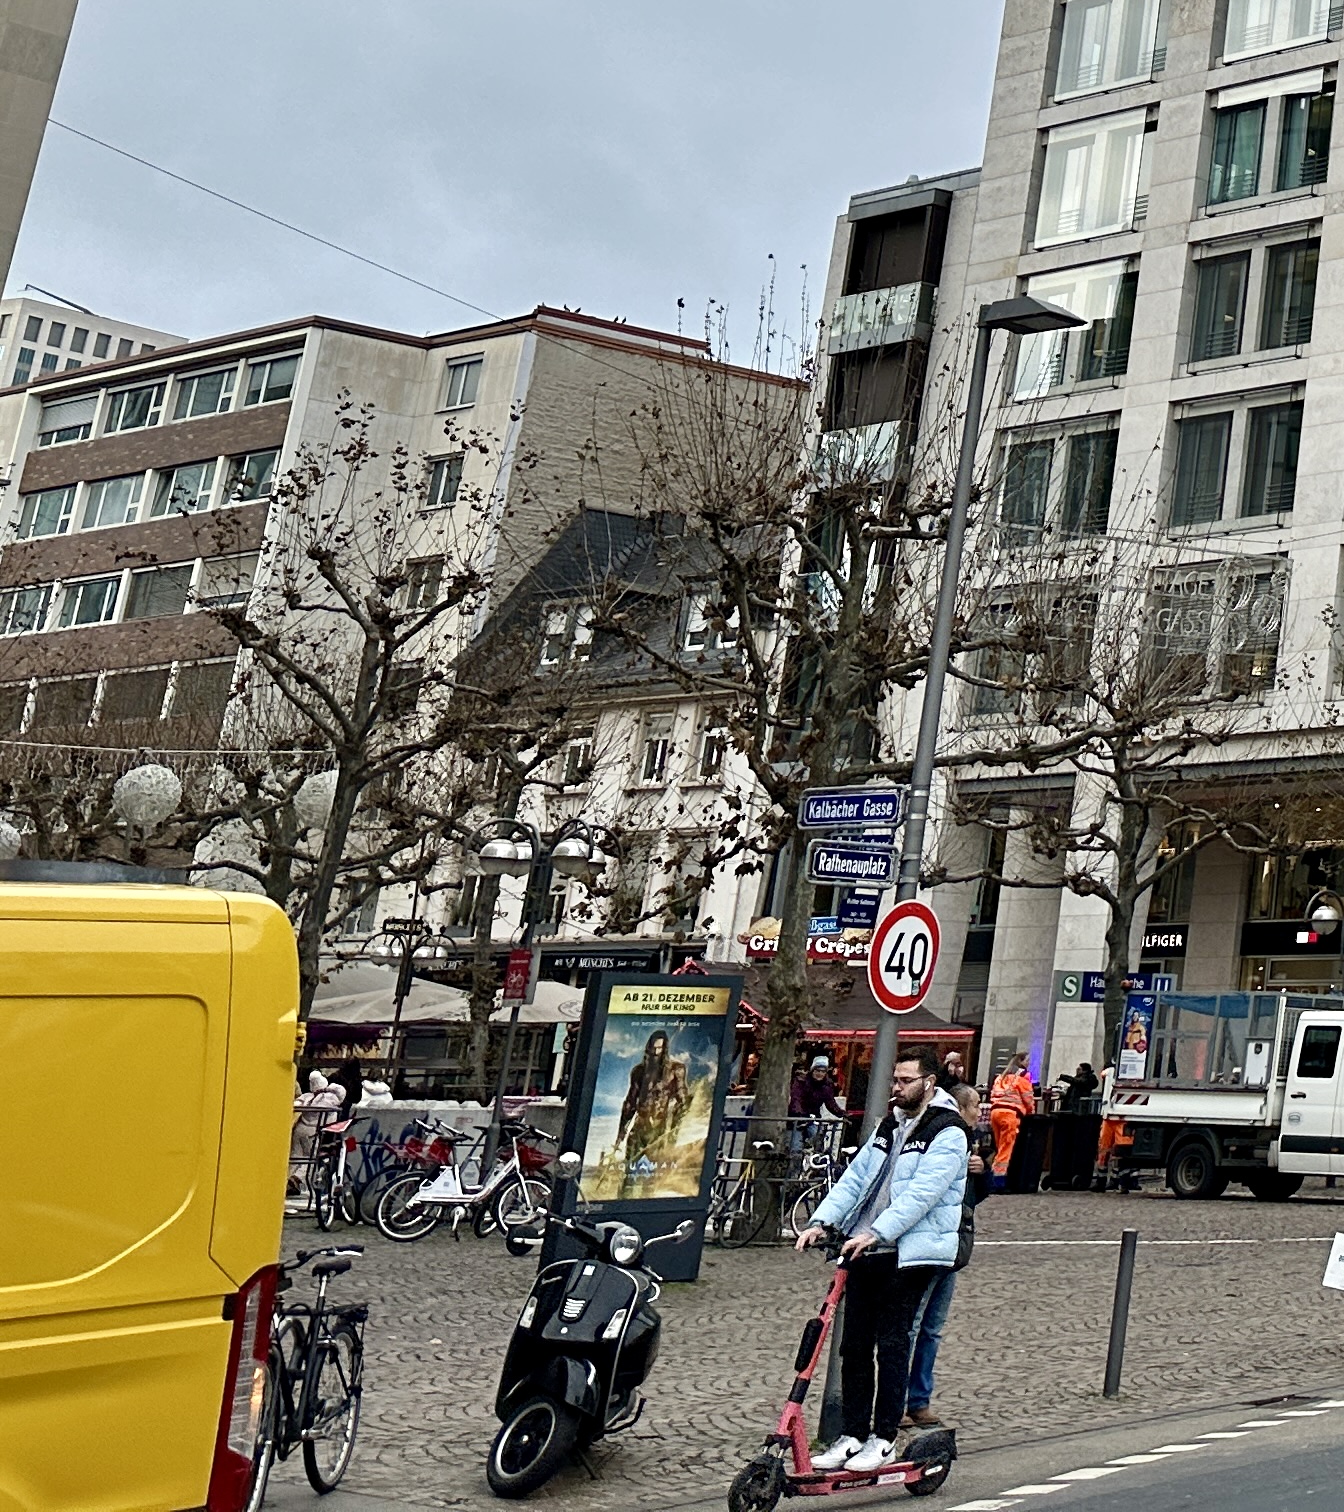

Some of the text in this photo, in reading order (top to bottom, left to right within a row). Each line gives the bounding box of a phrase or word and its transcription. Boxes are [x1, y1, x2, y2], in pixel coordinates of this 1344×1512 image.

[808, 798, 894, 819] Kalbächer Gasse
[818, 852, 887, 877] Rathenauplatz
[884, 932, 929, 980] 40
[1063, 976, 1078, 997] S
[623, 993, 639, 1002] AB
[658, 993, 716, 1004] DEZEMBER
[641, 1003, 696, 1011] NUR IM KINO
